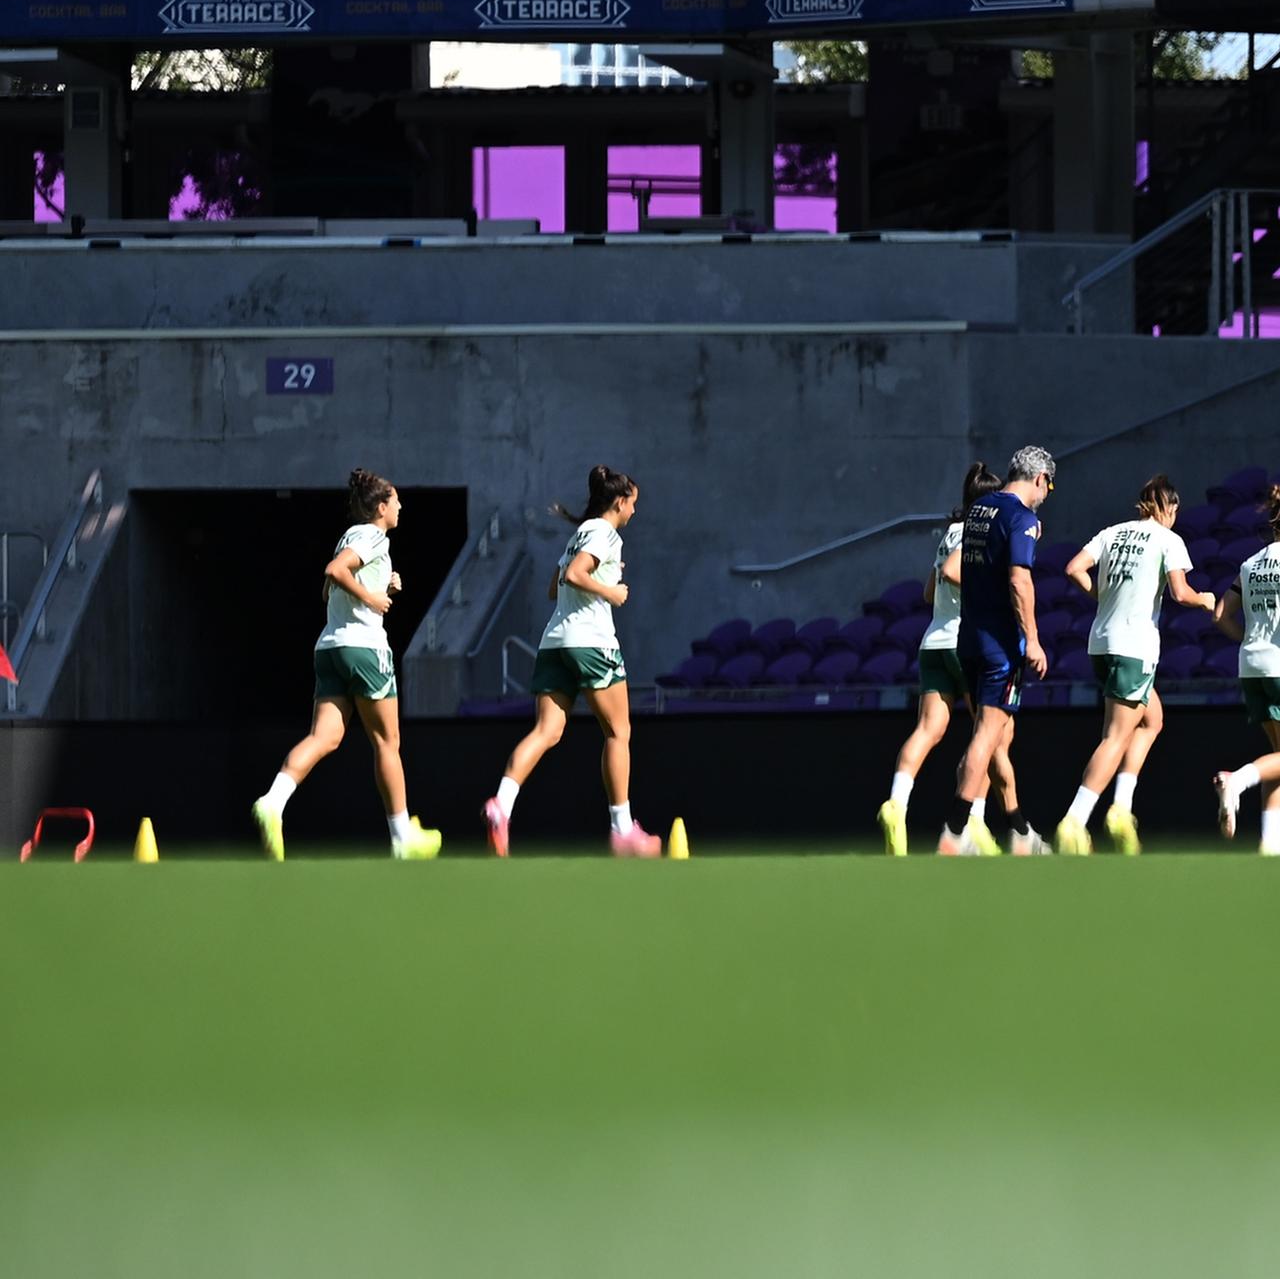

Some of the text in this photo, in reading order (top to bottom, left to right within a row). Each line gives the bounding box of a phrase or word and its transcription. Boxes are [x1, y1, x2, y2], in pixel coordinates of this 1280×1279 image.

[186, 3, 285, 23] TERRACE
[503, 0, 602, 19] TERRACE
[283, 363, 316, 389] 29
[979, 506, 999, 519] TIM
[965, 518, 991, 533] Poste
[1127, 530, 1151, 543] TIM
[1110, 543, 1144, 556] Poste
[1248, 572, 1280, 584] Poste
[1251, 599, 1265, 613] eni
